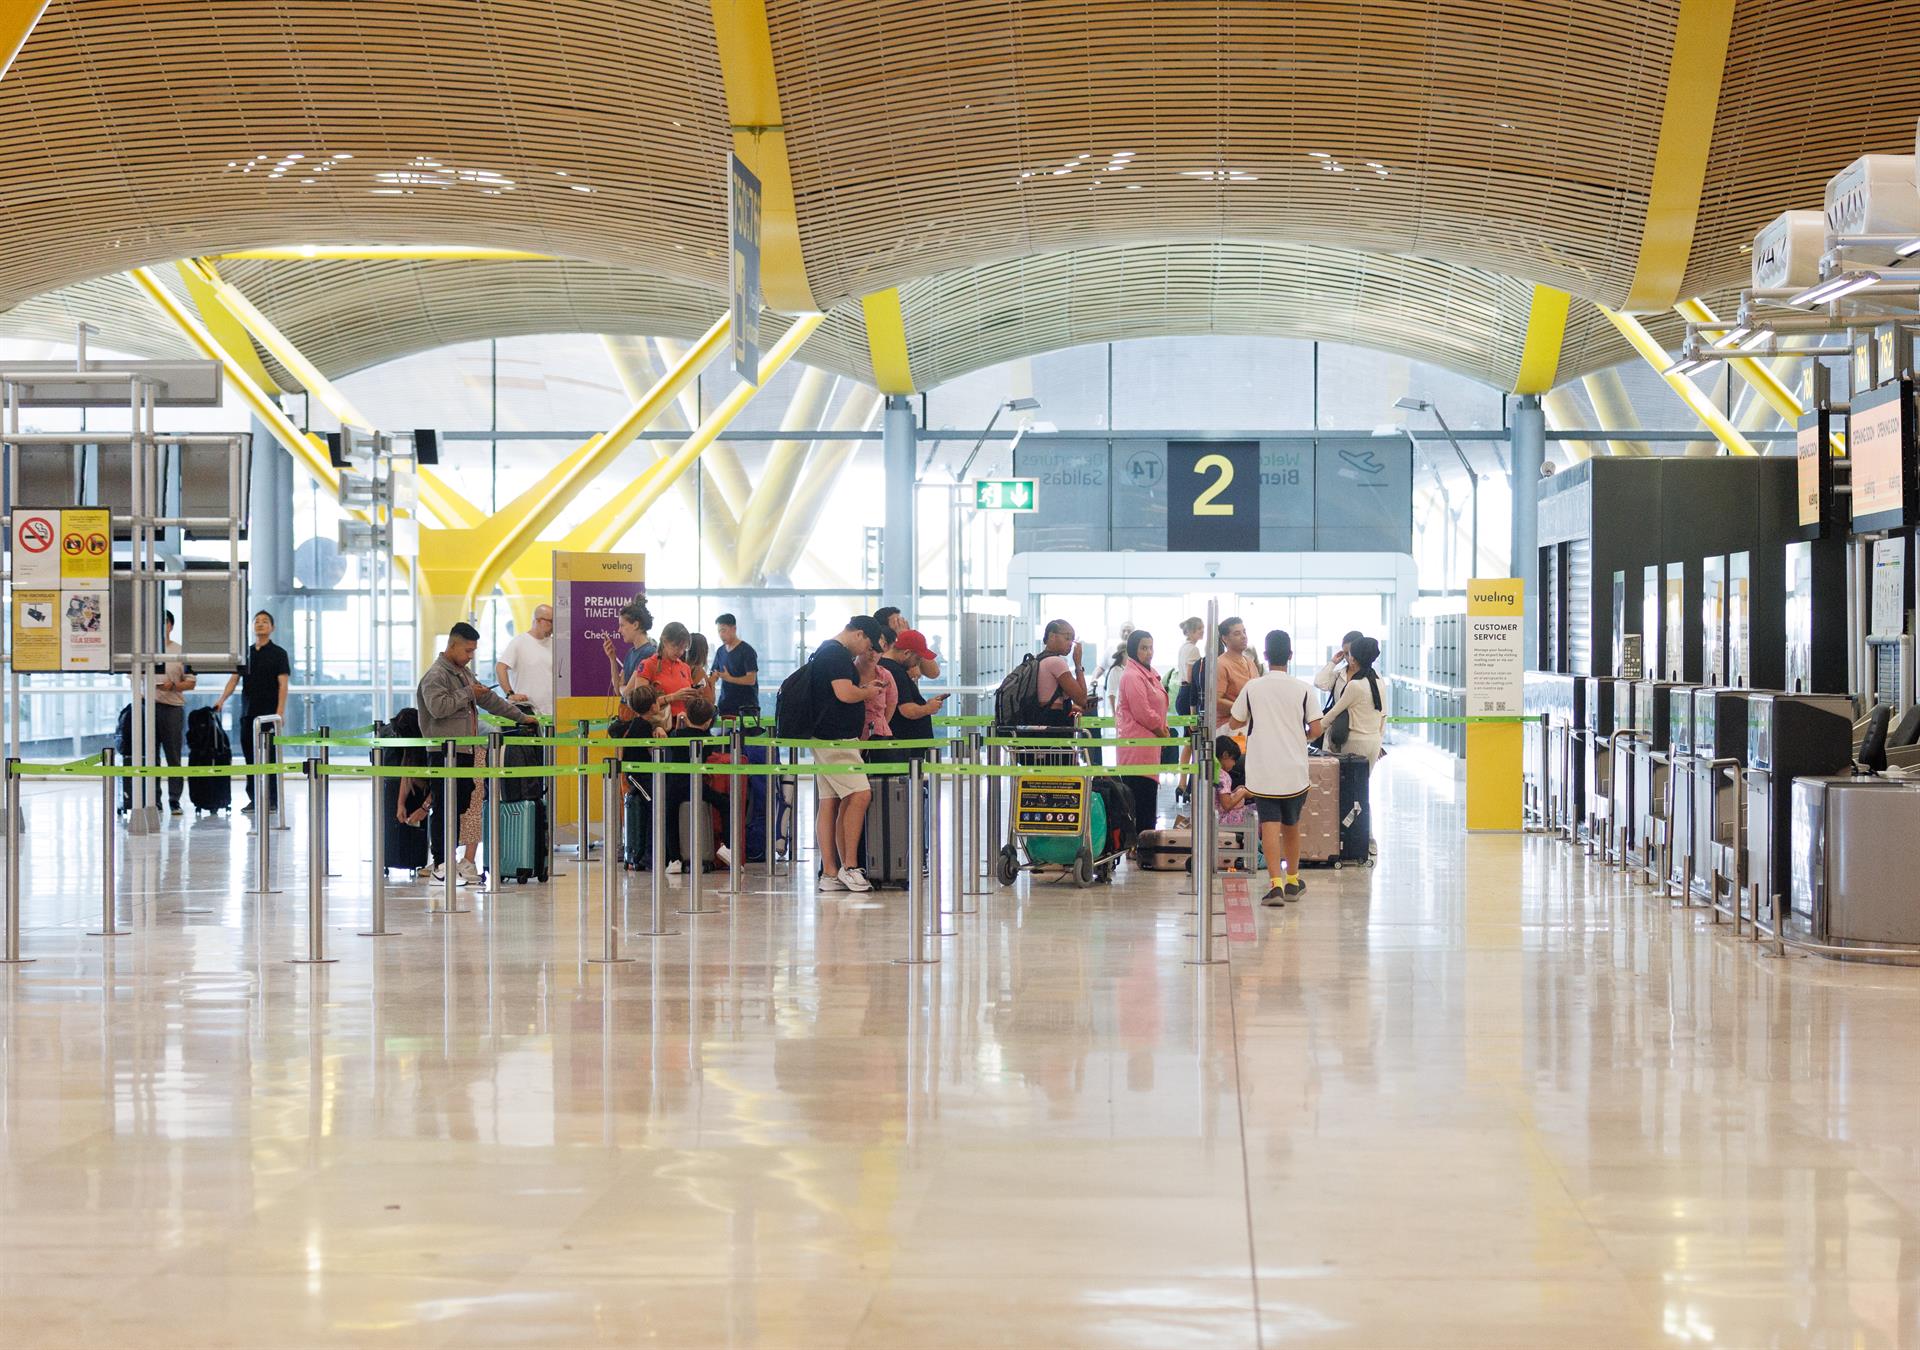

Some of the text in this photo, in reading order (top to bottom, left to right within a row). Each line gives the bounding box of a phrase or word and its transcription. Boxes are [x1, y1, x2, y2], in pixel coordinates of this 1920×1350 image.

[1880, 331, 1893, 369] 762
[1193, 454, 1234, 516] 2
[601, 561, 633, 573] vueling
[584, 596, 632, 607] PREMIUM
[1473, 591, 1515, 606] vueling
[584, 607, 621, 618] TIMEFL
[1473, 623, 1518, 631] CUSTOMER
[584, 630, 621, 639] Check-in
[1473, 633, 1507, 641] SERVICE
